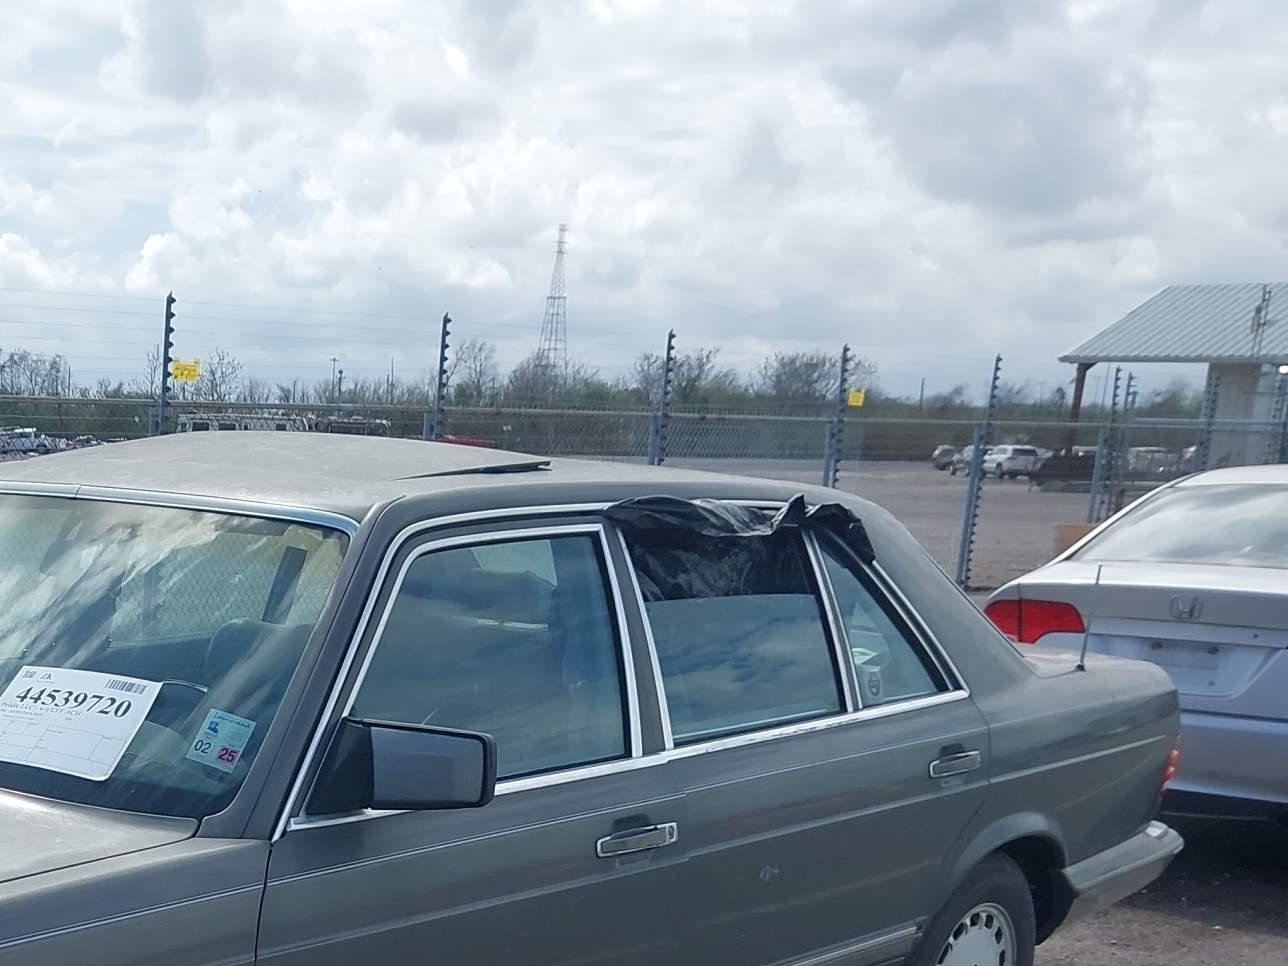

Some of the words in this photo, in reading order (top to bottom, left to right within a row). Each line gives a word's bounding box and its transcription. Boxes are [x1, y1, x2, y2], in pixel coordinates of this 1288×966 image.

[15, 686, 132, 718] 44539720
[194, 739, 212, 754] 02
[217, 747, 237, 763] 25
